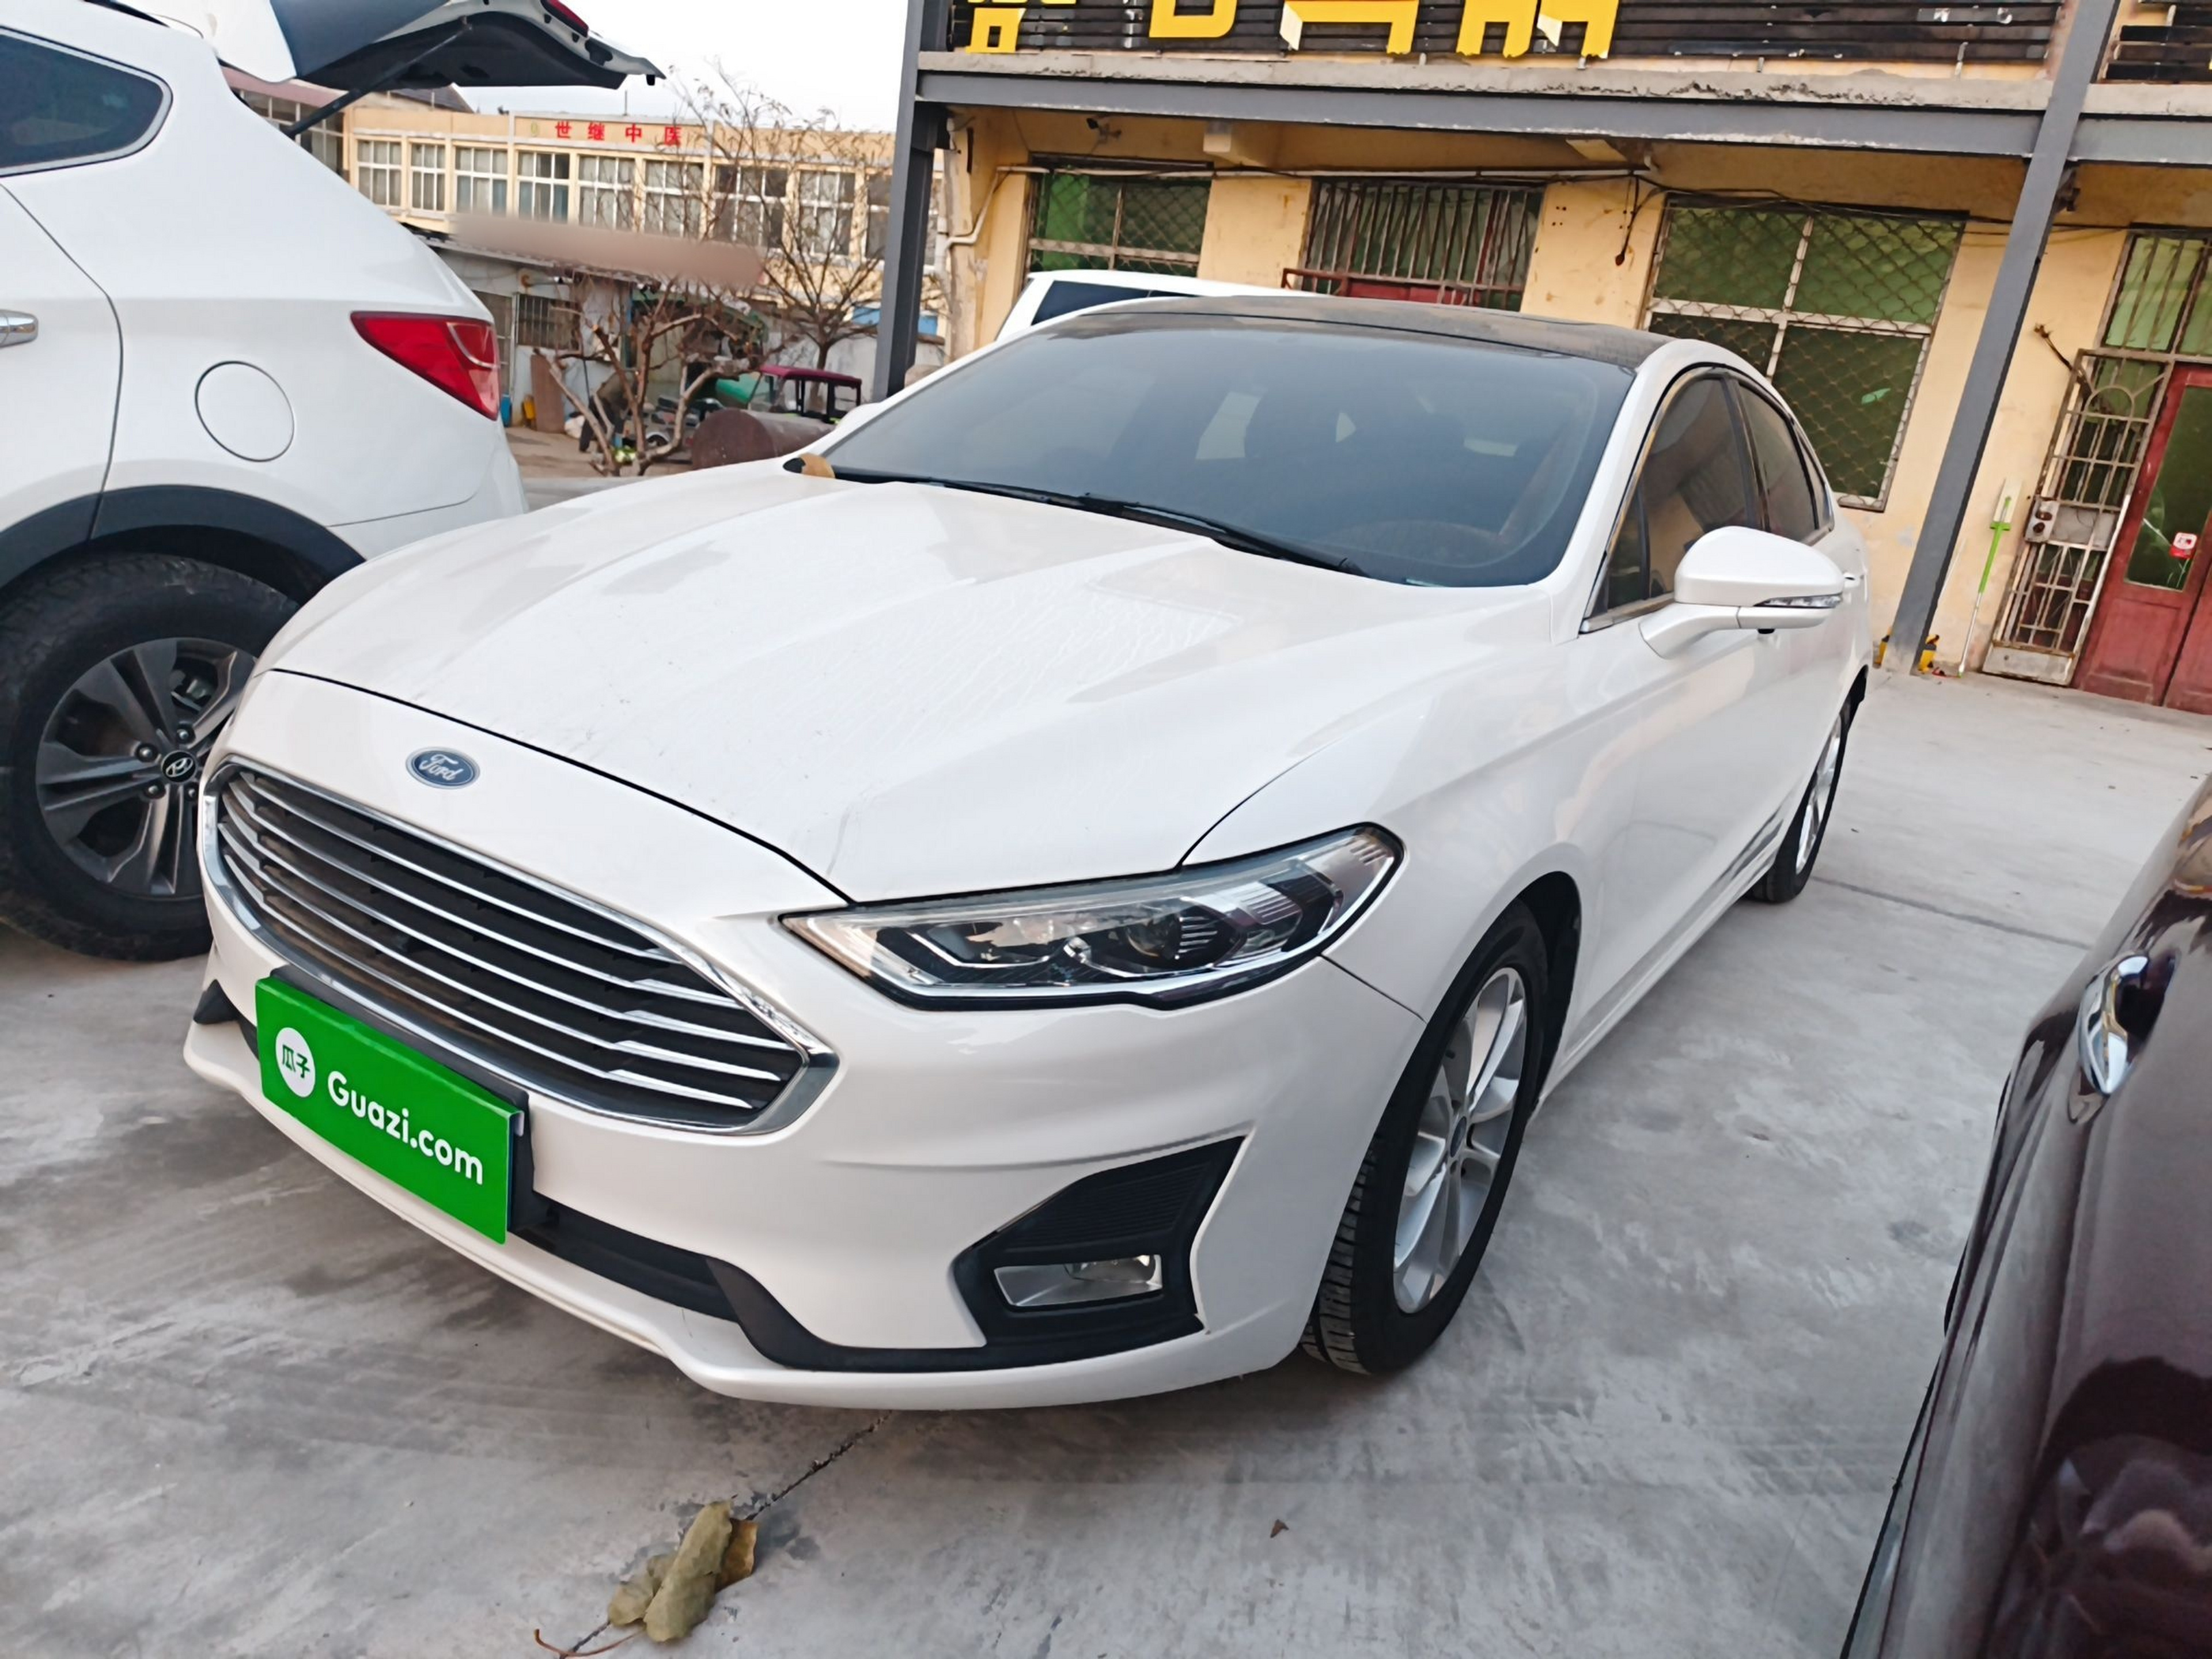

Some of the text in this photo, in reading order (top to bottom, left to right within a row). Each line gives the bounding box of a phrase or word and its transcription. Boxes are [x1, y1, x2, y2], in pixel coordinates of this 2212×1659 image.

[418, 753, 464, 781] Ford
[282, 1044, 310, 1078] 瓜子
[327, 1070, 483, 1185] Guazi.com
